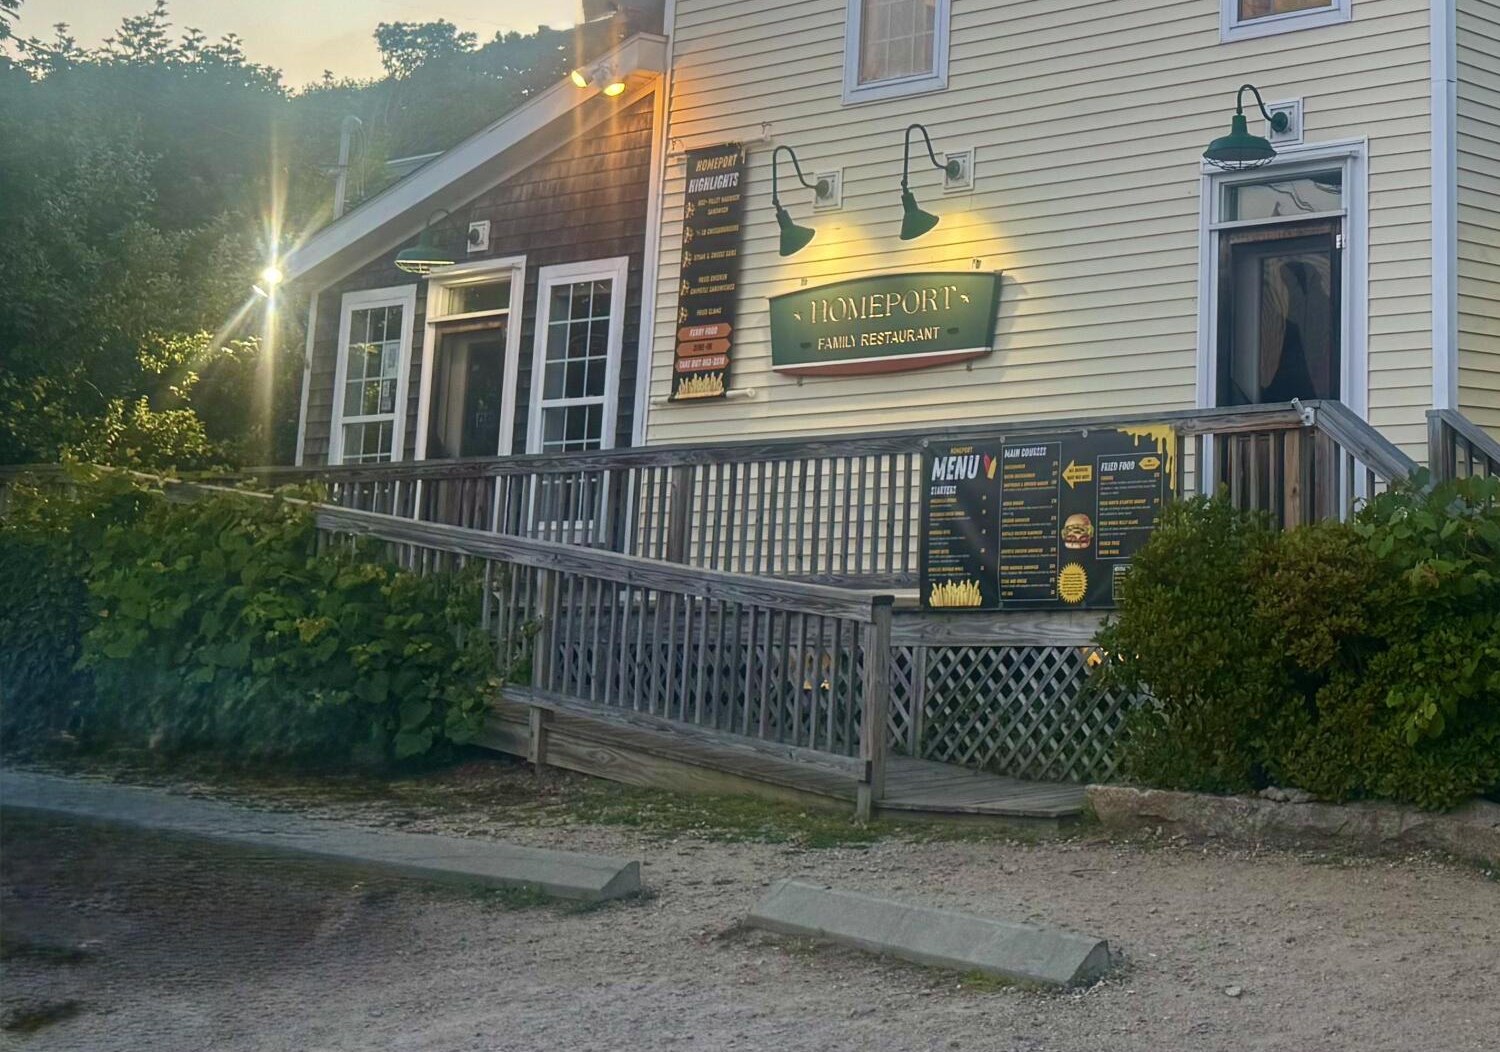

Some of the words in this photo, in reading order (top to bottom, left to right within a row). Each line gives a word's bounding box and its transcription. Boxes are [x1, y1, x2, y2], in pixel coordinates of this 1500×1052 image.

[695, 154, 738, 173] HOMEPORT
[688, 172, 740, 194] HIGHLIGHTS
[810, 285, 958, 325] HOMEPORT
[817, 334, 857, 351] FAMILY
[860, 326, 941, 347] RESTAURANT
[1004, 448, 1021, 459] MAIN
[931, 454, 980, 481] MENU
[1119, 460, 1136, 471] FOOD
